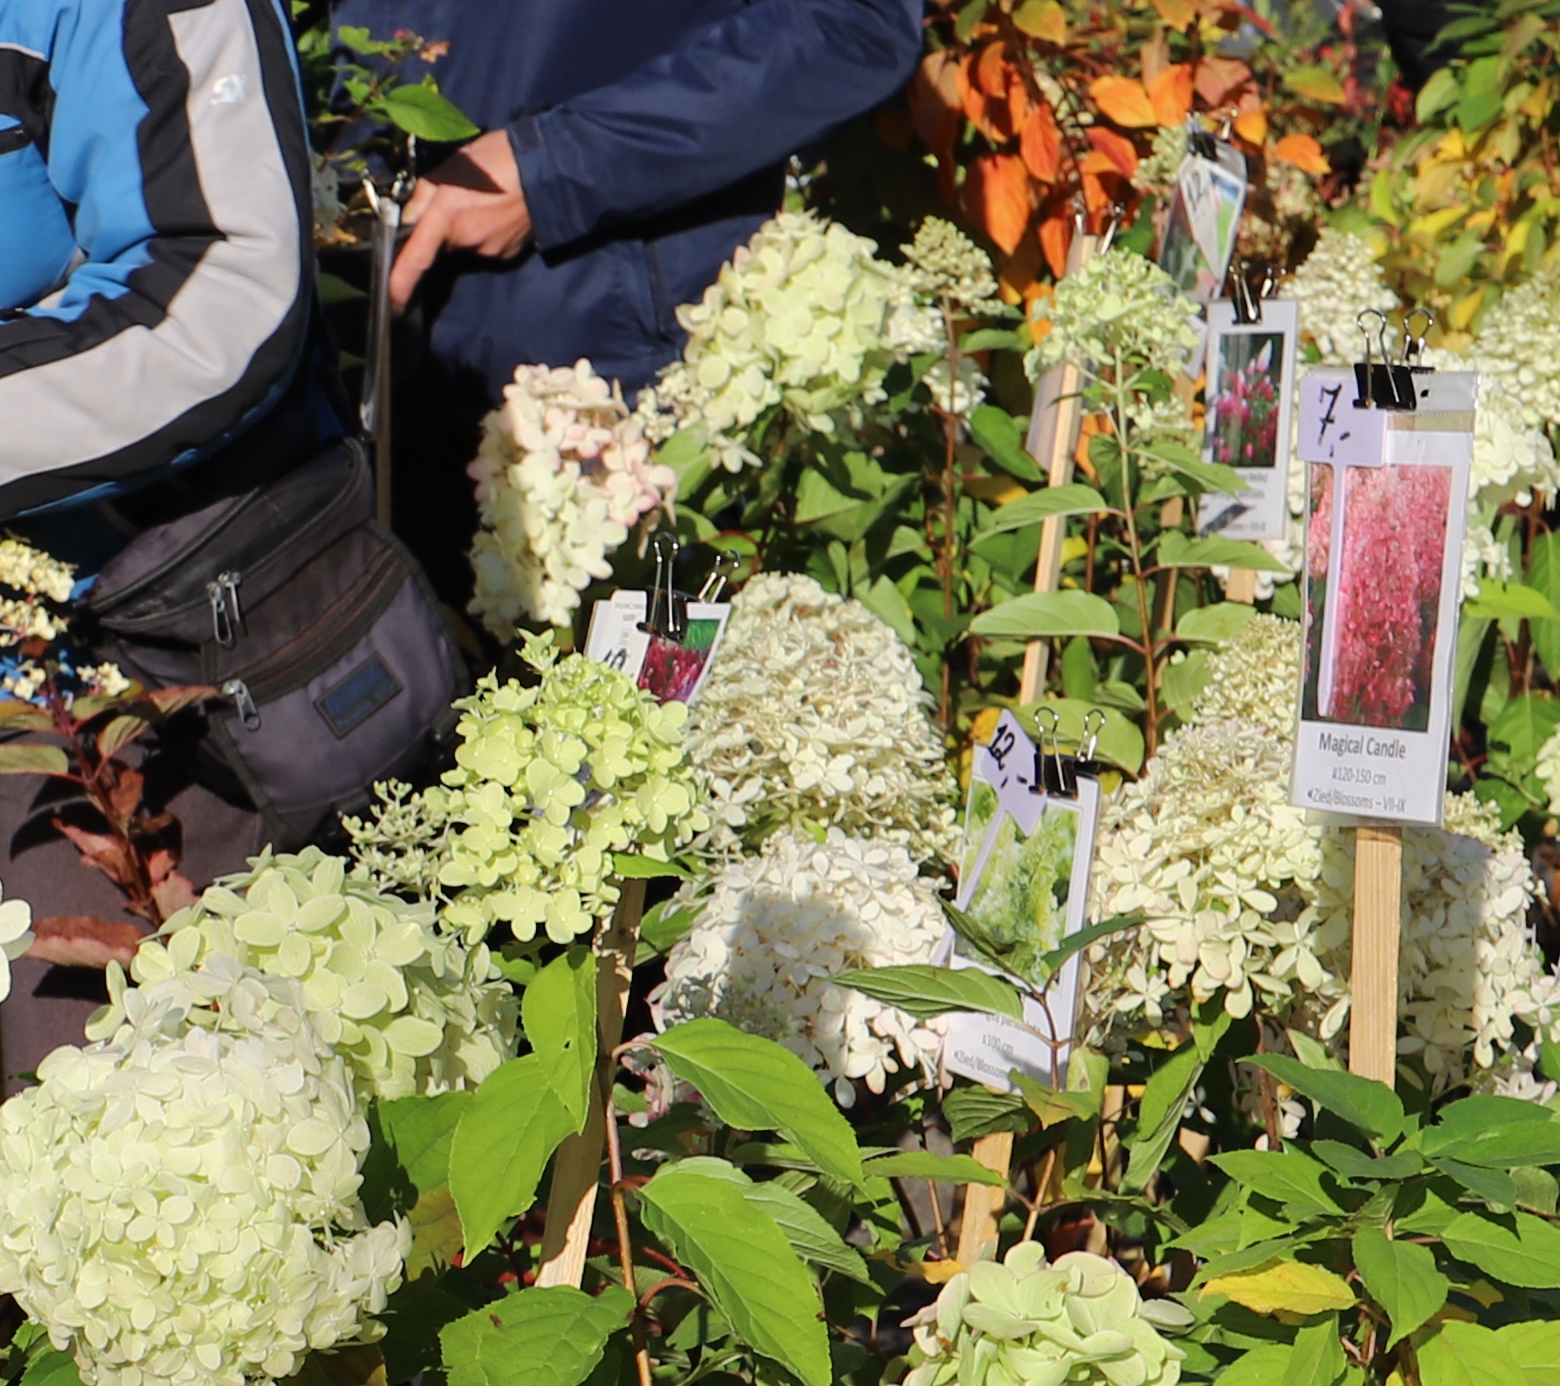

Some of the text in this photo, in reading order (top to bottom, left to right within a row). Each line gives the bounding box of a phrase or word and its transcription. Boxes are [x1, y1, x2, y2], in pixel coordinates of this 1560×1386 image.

[1318, 732, 1407, 760] Magical Candle
[1337, 766, 1387, 786] 120-150 cm
[1312, 787, 1374, 810] Zied/Blossoms
[958, 1050, 1009, 1078] Zied/Blossom
